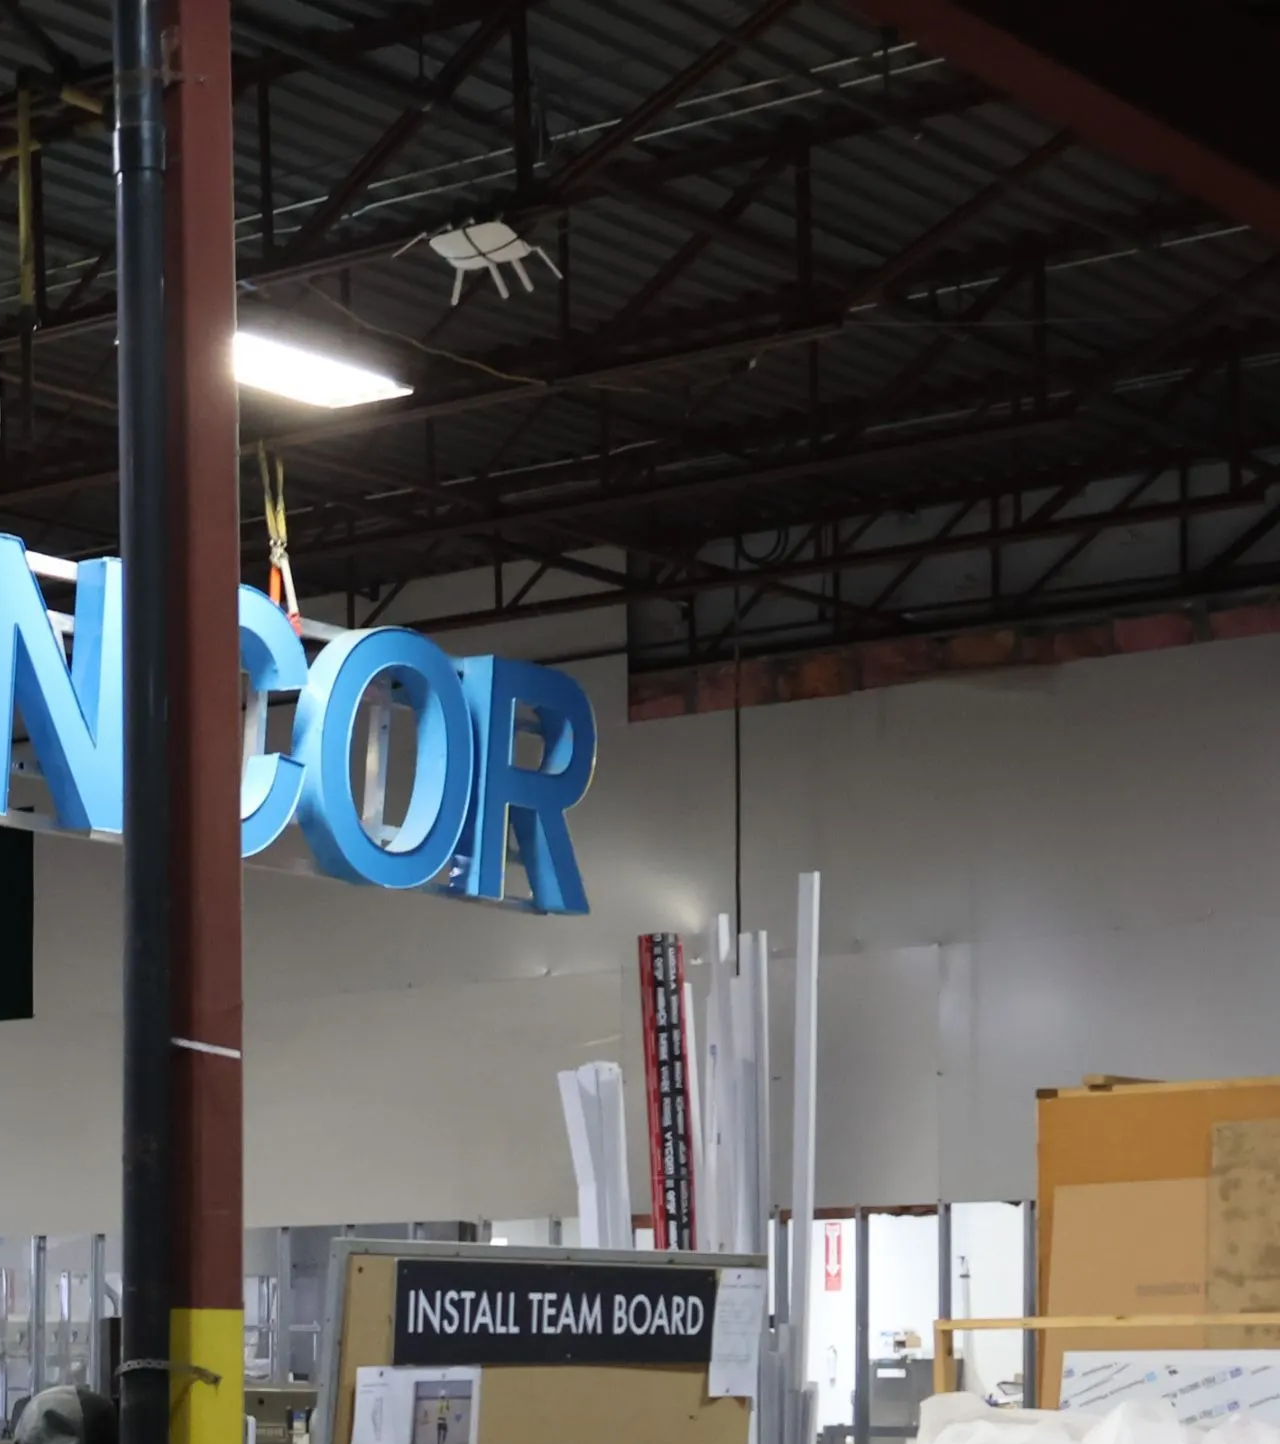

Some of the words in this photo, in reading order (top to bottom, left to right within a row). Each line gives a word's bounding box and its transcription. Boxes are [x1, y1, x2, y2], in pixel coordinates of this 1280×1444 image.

[407, 1289, 520, 1335] INSTALL
[528, 1292, 603, 1336] TEAM
[612, 1294, 705, 1336] BOARD
